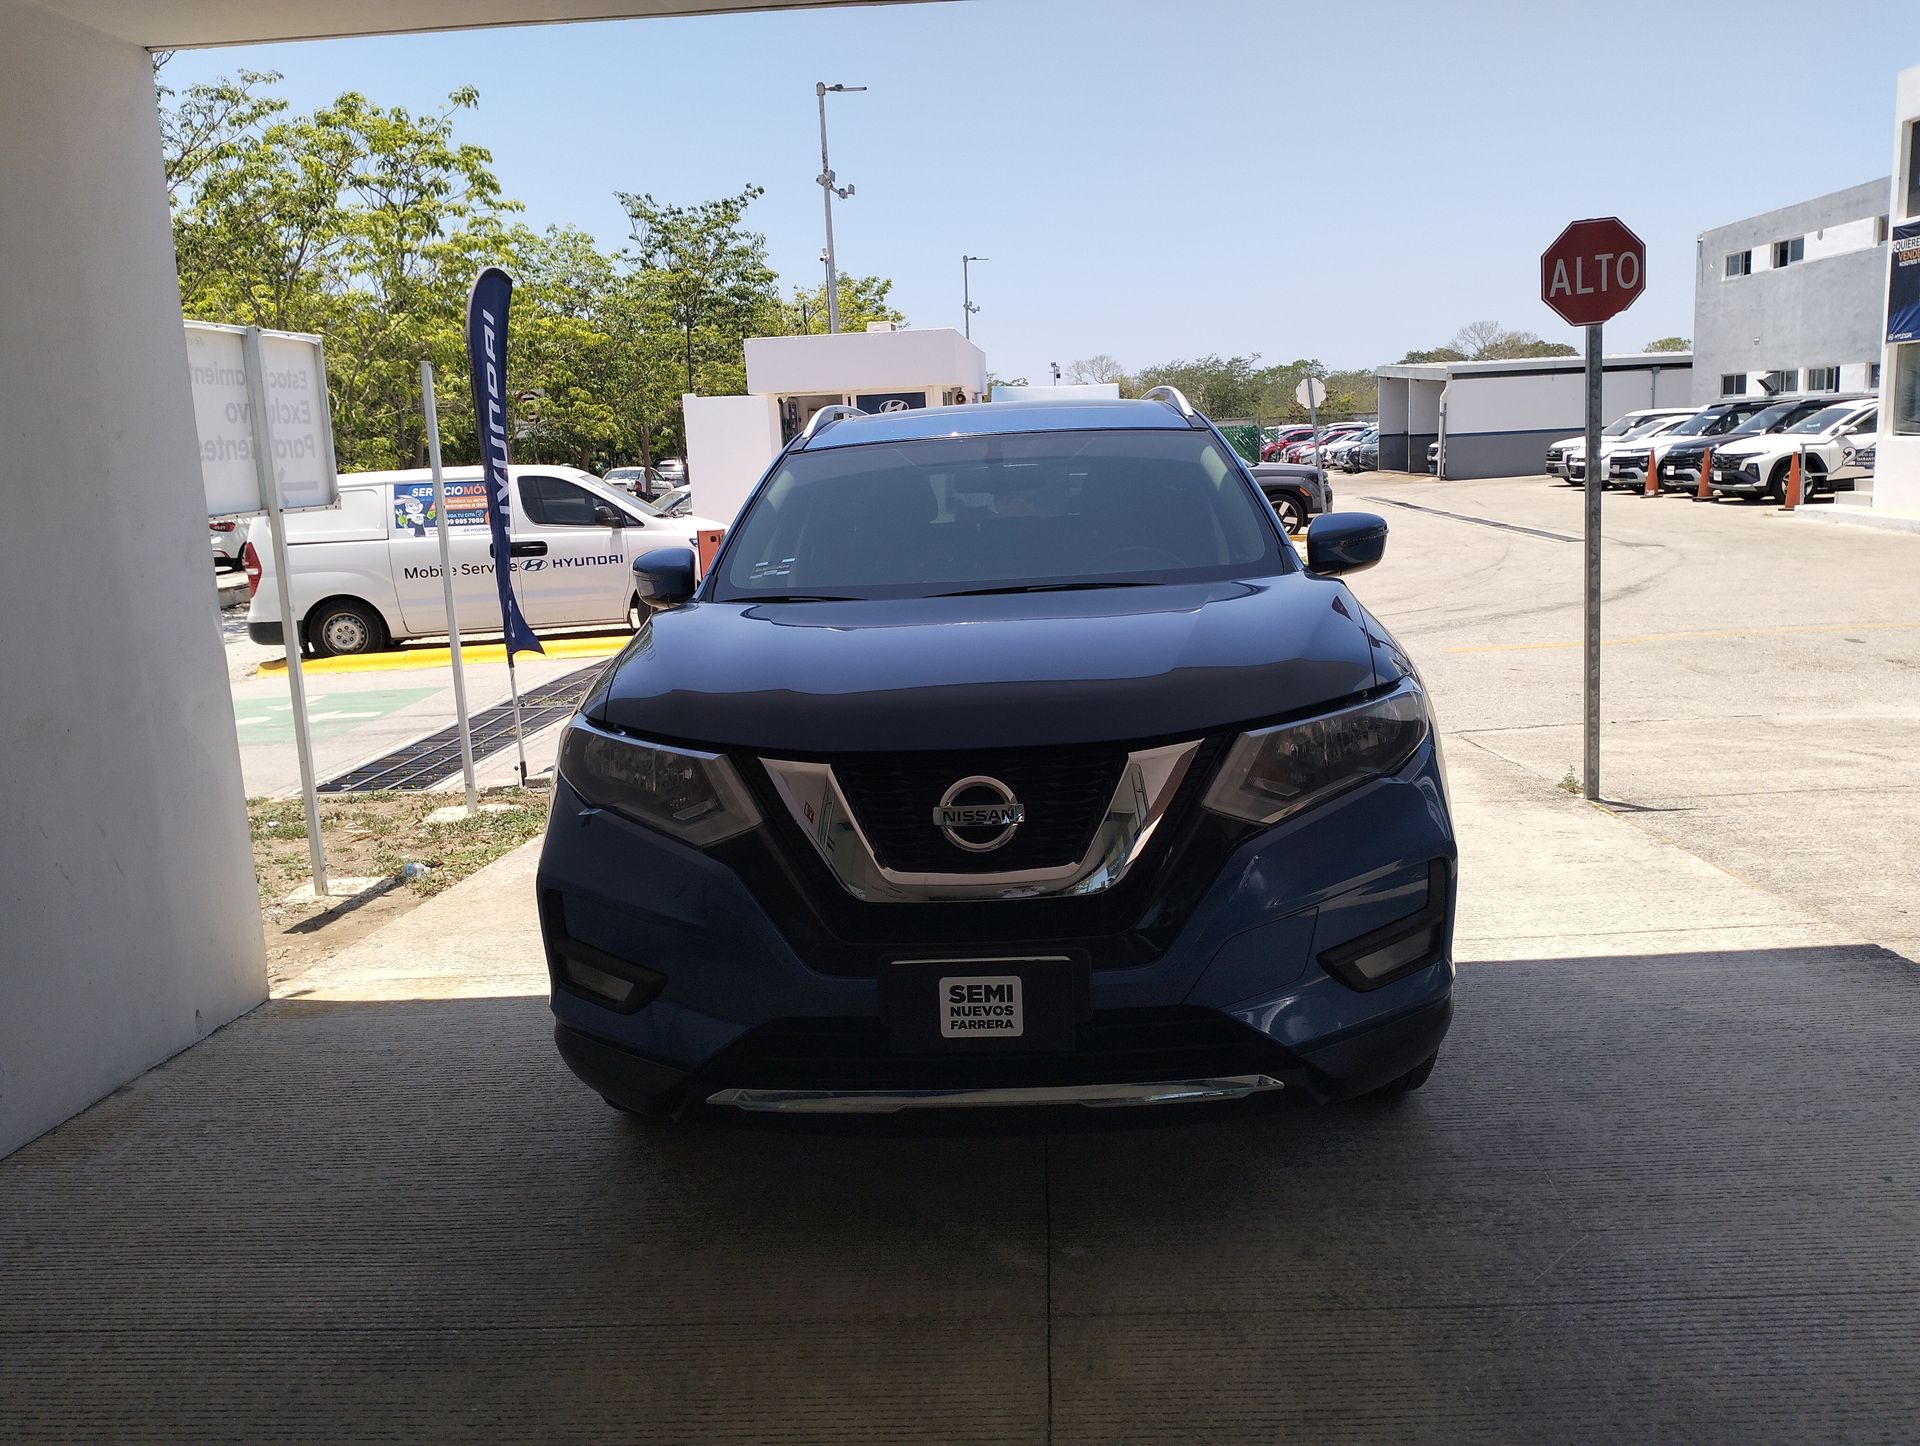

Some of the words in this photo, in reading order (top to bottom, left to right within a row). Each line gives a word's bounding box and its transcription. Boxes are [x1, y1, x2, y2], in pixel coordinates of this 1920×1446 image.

[1549, 251, 1640, 298] ALTO
[411, 486, 463, 498] SERCIO
[463, 484, 487, 495] MÓV
[404, 565, 457, 580] Mobie
[461, 563, 518, 576] Serve
[552, 554, 624, 569] HYUNDAI
[943, 808, 1015, 822] NISSAN
[948, 984, 1014, 1004] SEMI
[950, 1005, 1014, 1017] NUEVOS
[950, 1019, 1014, 1030] FARRERA
